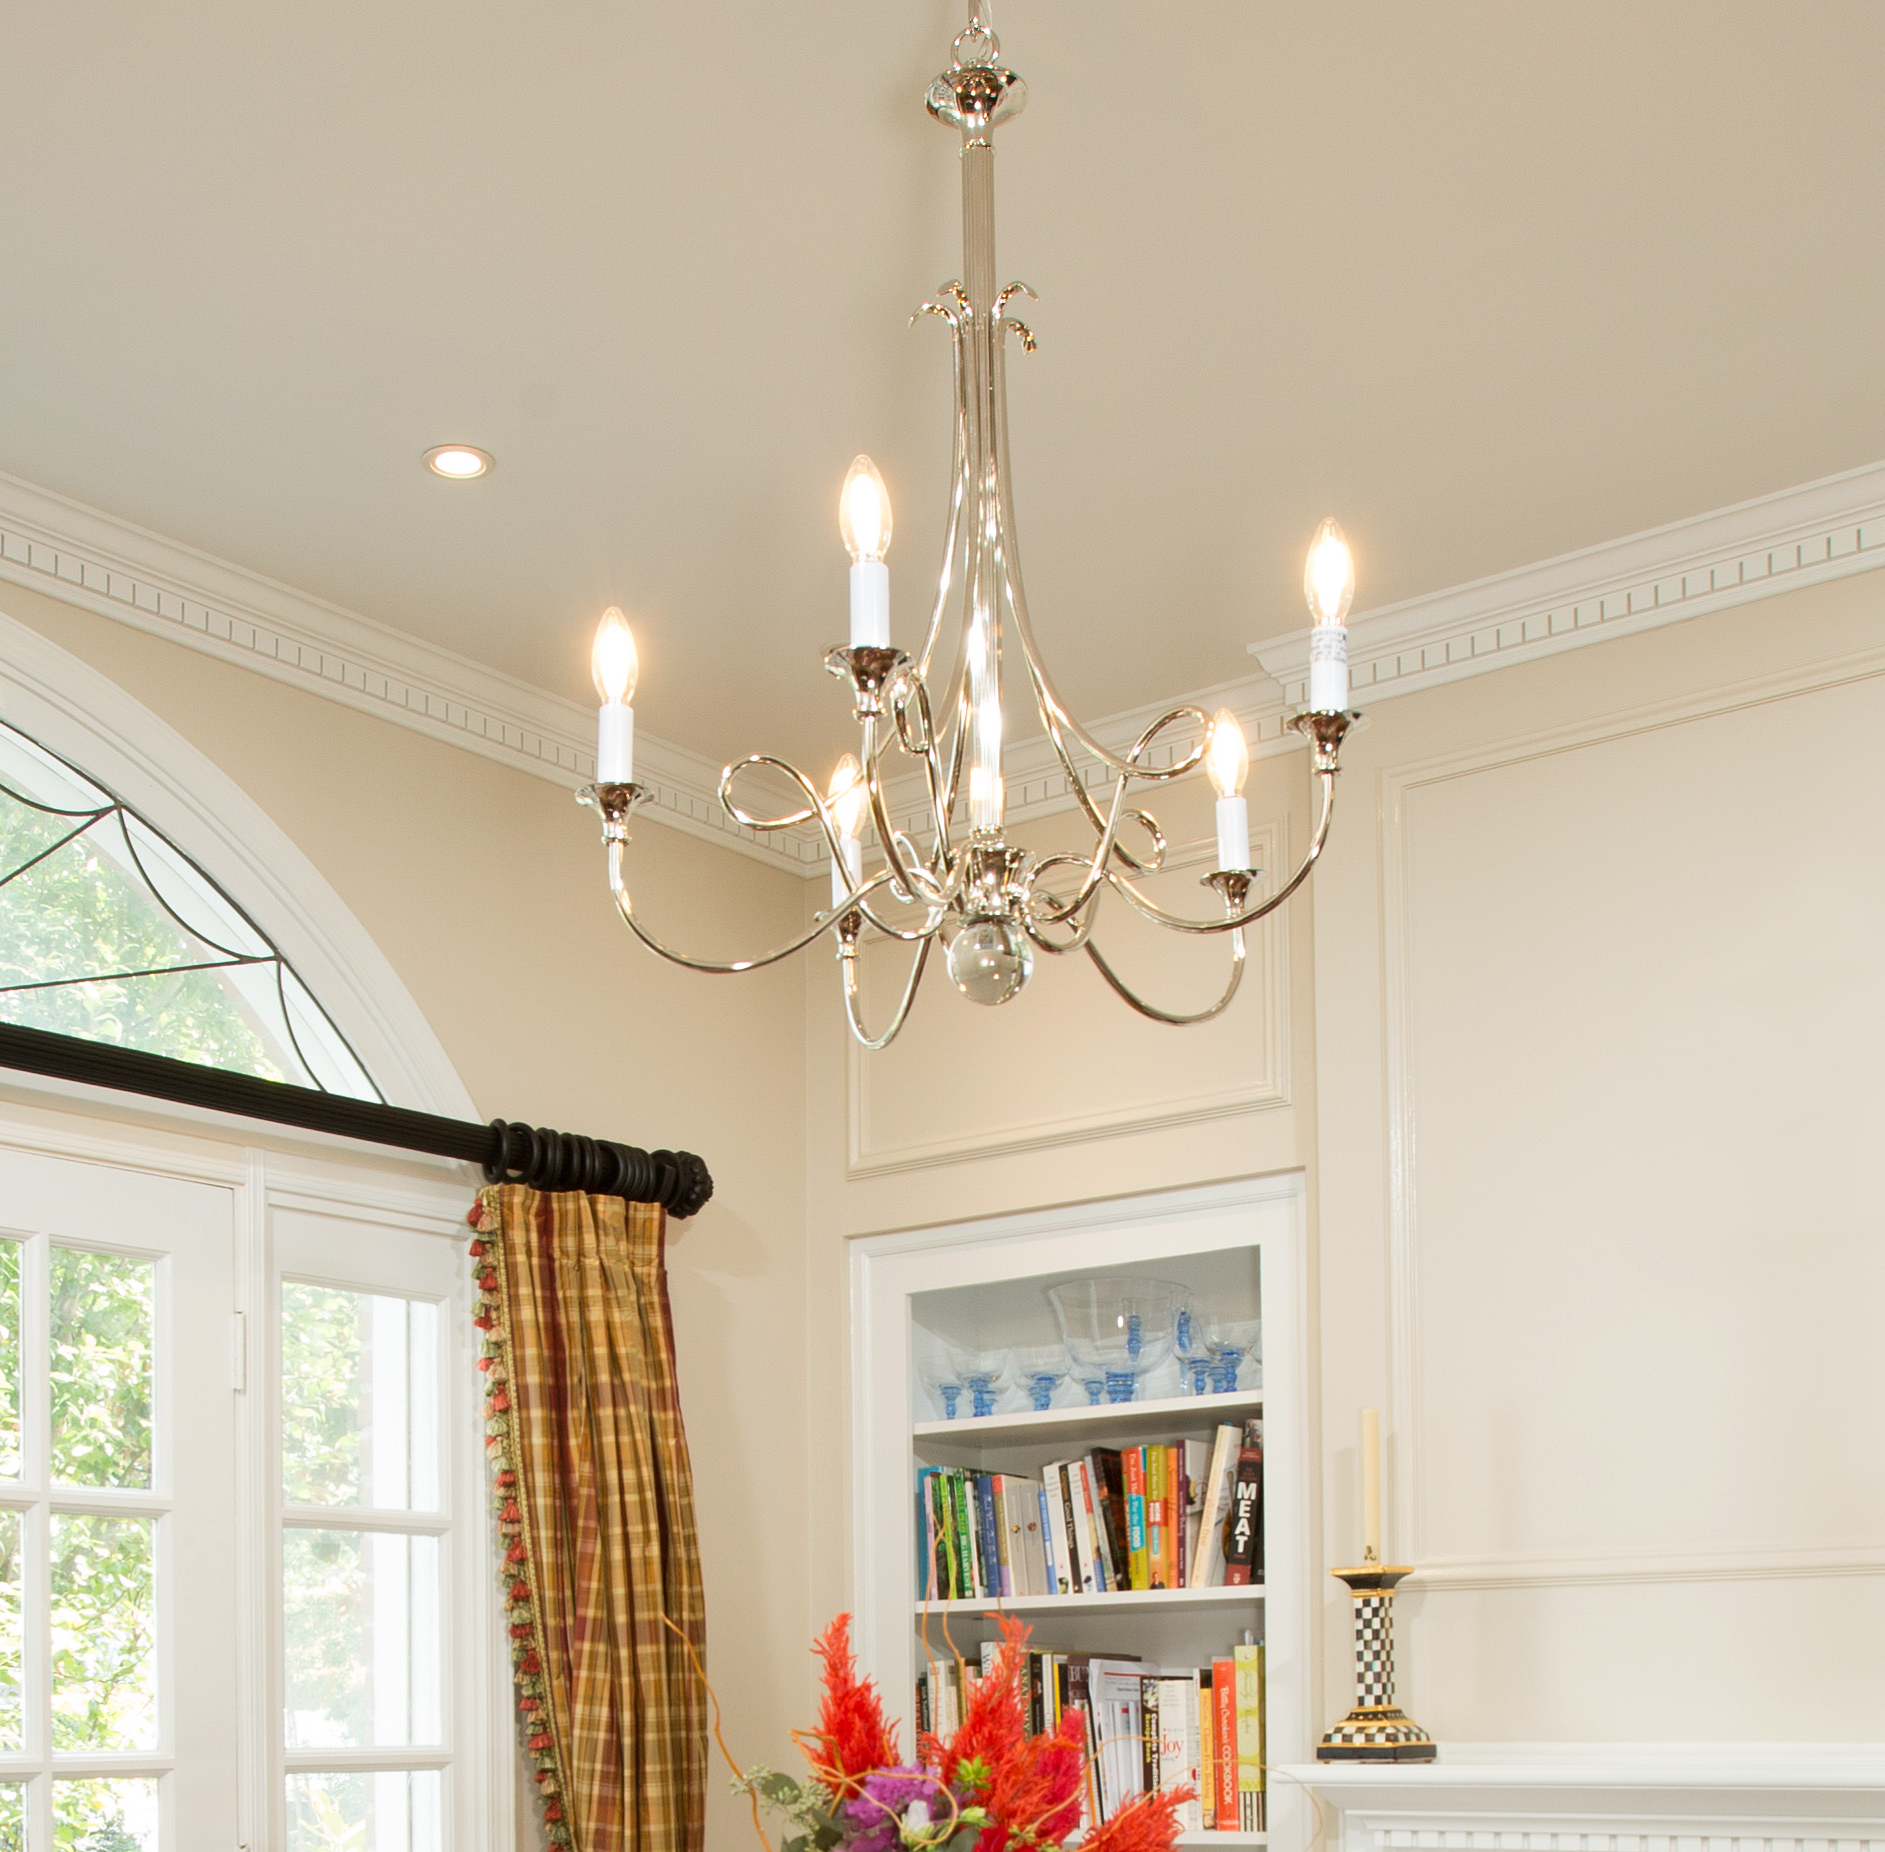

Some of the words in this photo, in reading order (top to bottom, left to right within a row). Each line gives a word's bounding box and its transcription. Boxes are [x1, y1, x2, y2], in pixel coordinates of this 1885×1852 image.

[1064, 1502, 1072, 1522] Good
[1234, 1482, 1257, 1553] MEAT
[1066, 1523, 1074, 1549] Things
[962, 1550, 970, 1588] HARVEST
[1219, 1686, 1229, 1708] Betty
[1223, 1745, 1232, 1805] COOKBOOK
